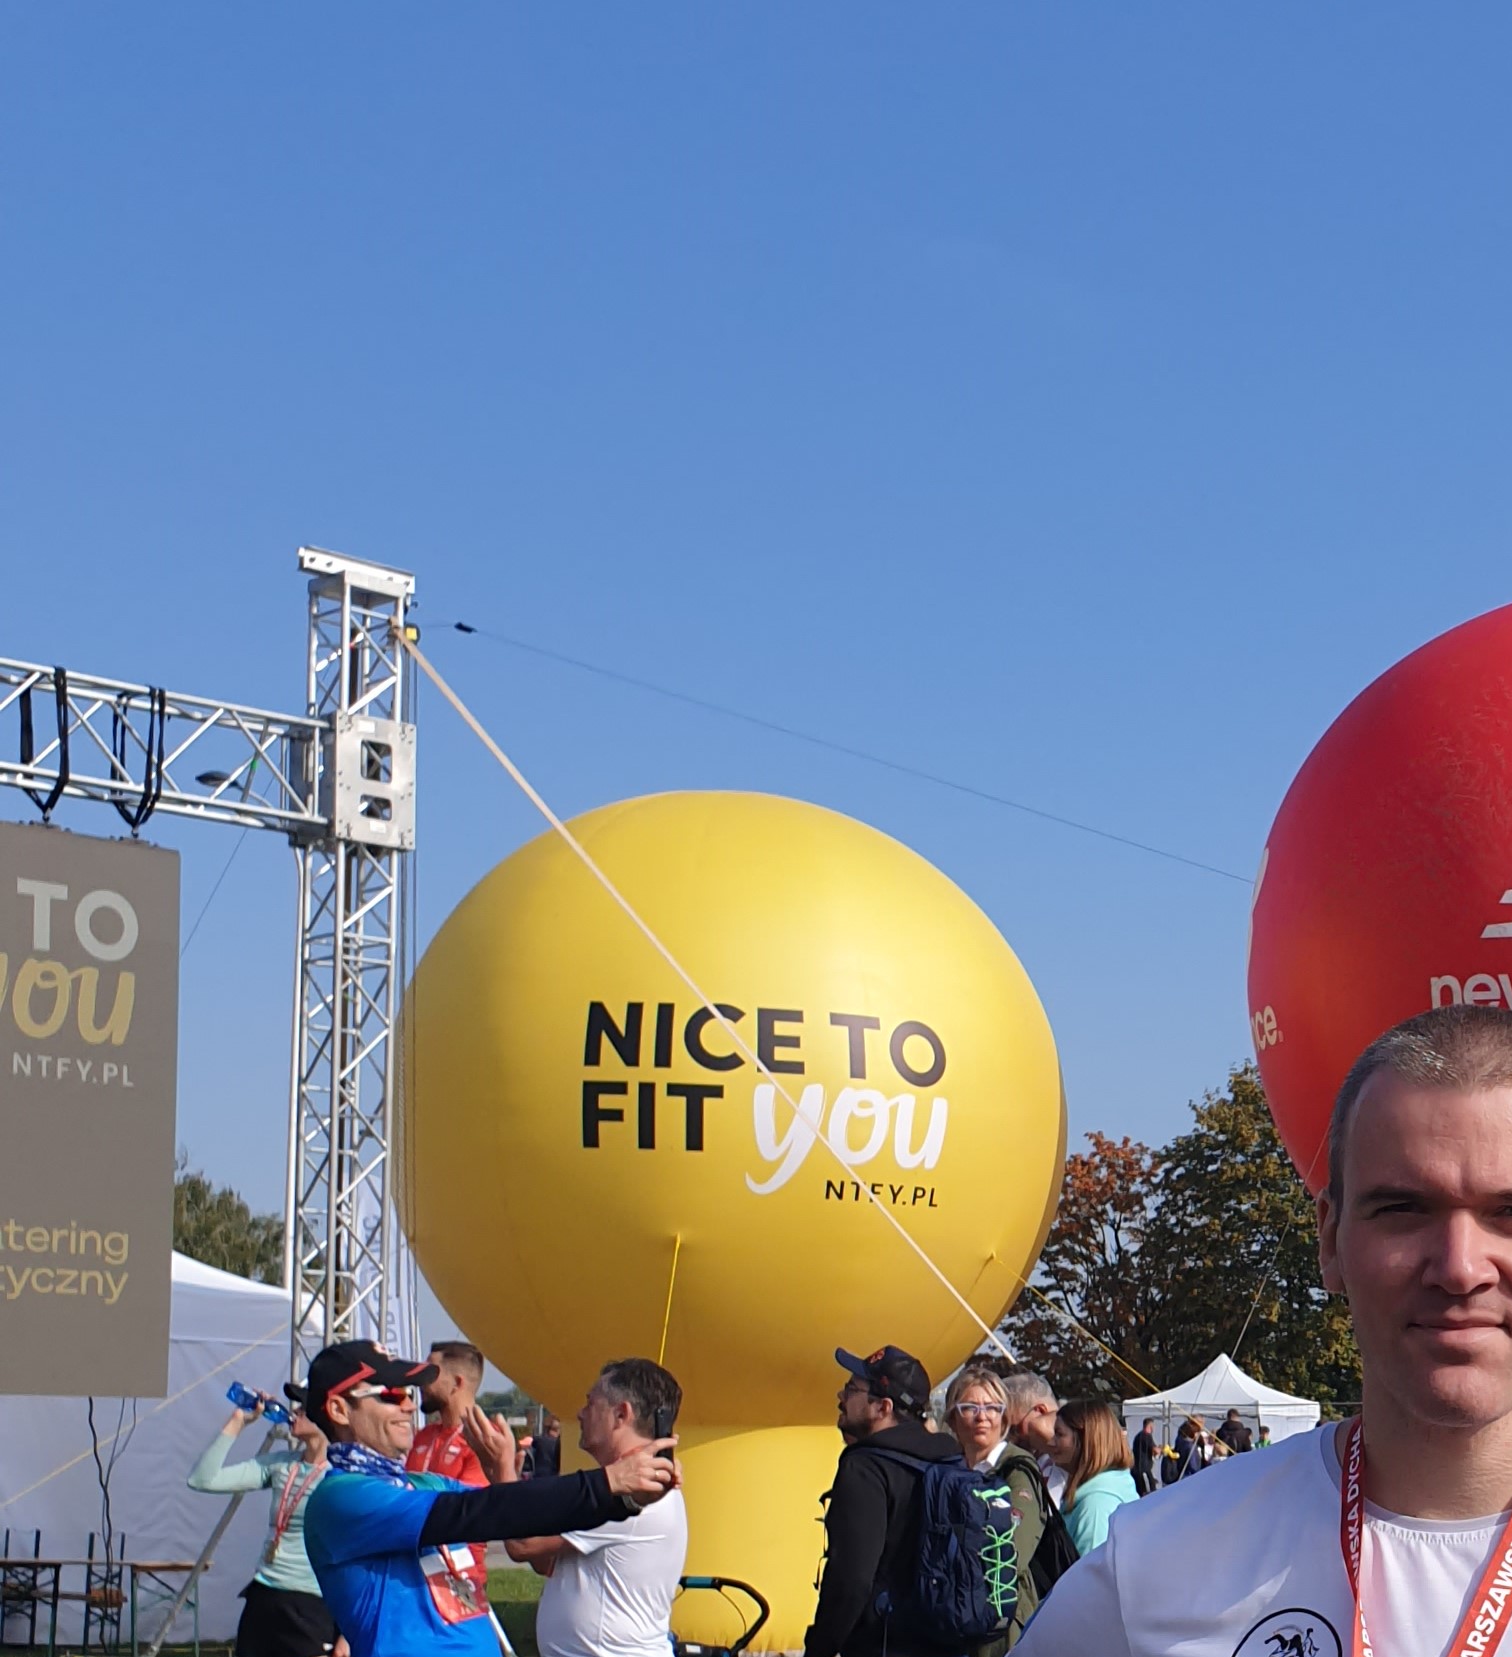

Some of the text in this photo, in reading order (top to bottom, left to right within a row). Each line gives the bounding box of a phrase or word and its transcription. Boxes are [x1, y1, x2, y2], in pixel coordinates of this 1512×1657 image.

[16, 876, 139, 962] TO
[12, 1051, 134, 1088] NTFY.PL
[583, 1001, 947, 1088] NICE TO
[582, 1080, 949, 1196] FIT you
[825, 1179, 939, 1208] NTFY.PL
[0, 1218, 129, 1265] tering
